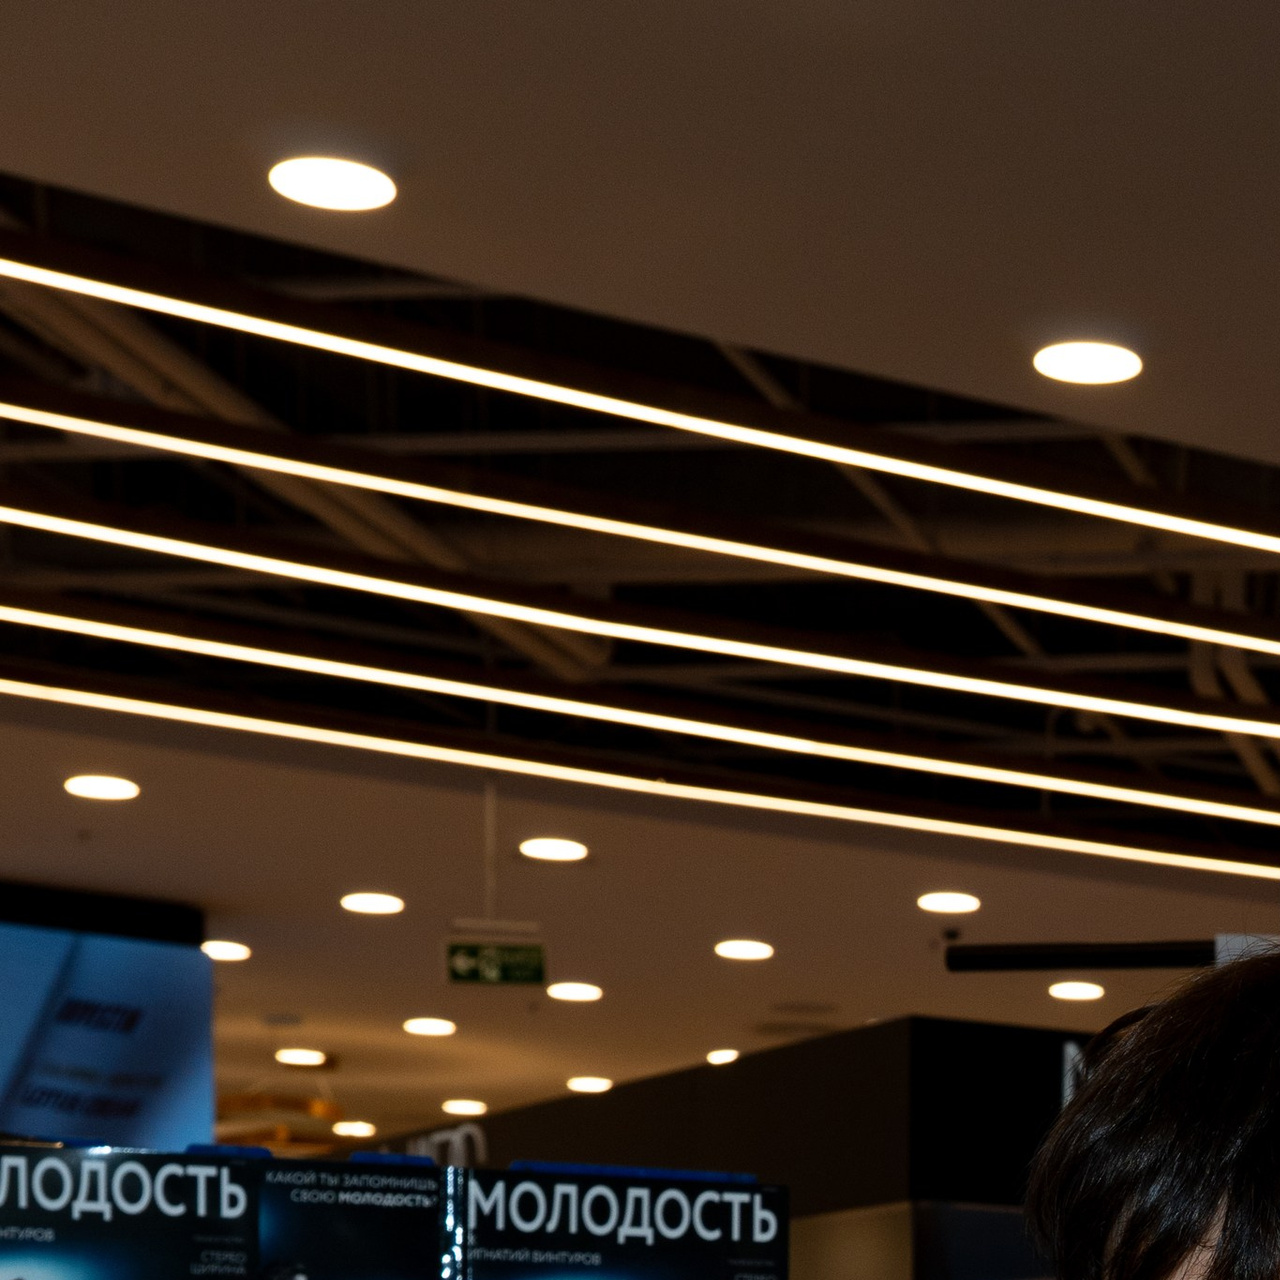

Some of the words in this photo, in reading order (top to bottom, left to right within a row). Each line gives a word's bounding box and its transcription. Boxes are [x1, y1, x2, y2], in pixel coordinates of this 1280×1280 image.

[0, 1154, 248, 1222] ЛОДОСТЬ
[266, 1169, 317, 1185] КАКОЙ
[320, 1172, 340, 1187] ТЫ
[467, 1178, 778, 1246] МОЛОДОСТЬ
[0, 1226, 56, 1242] НТУРОВ
